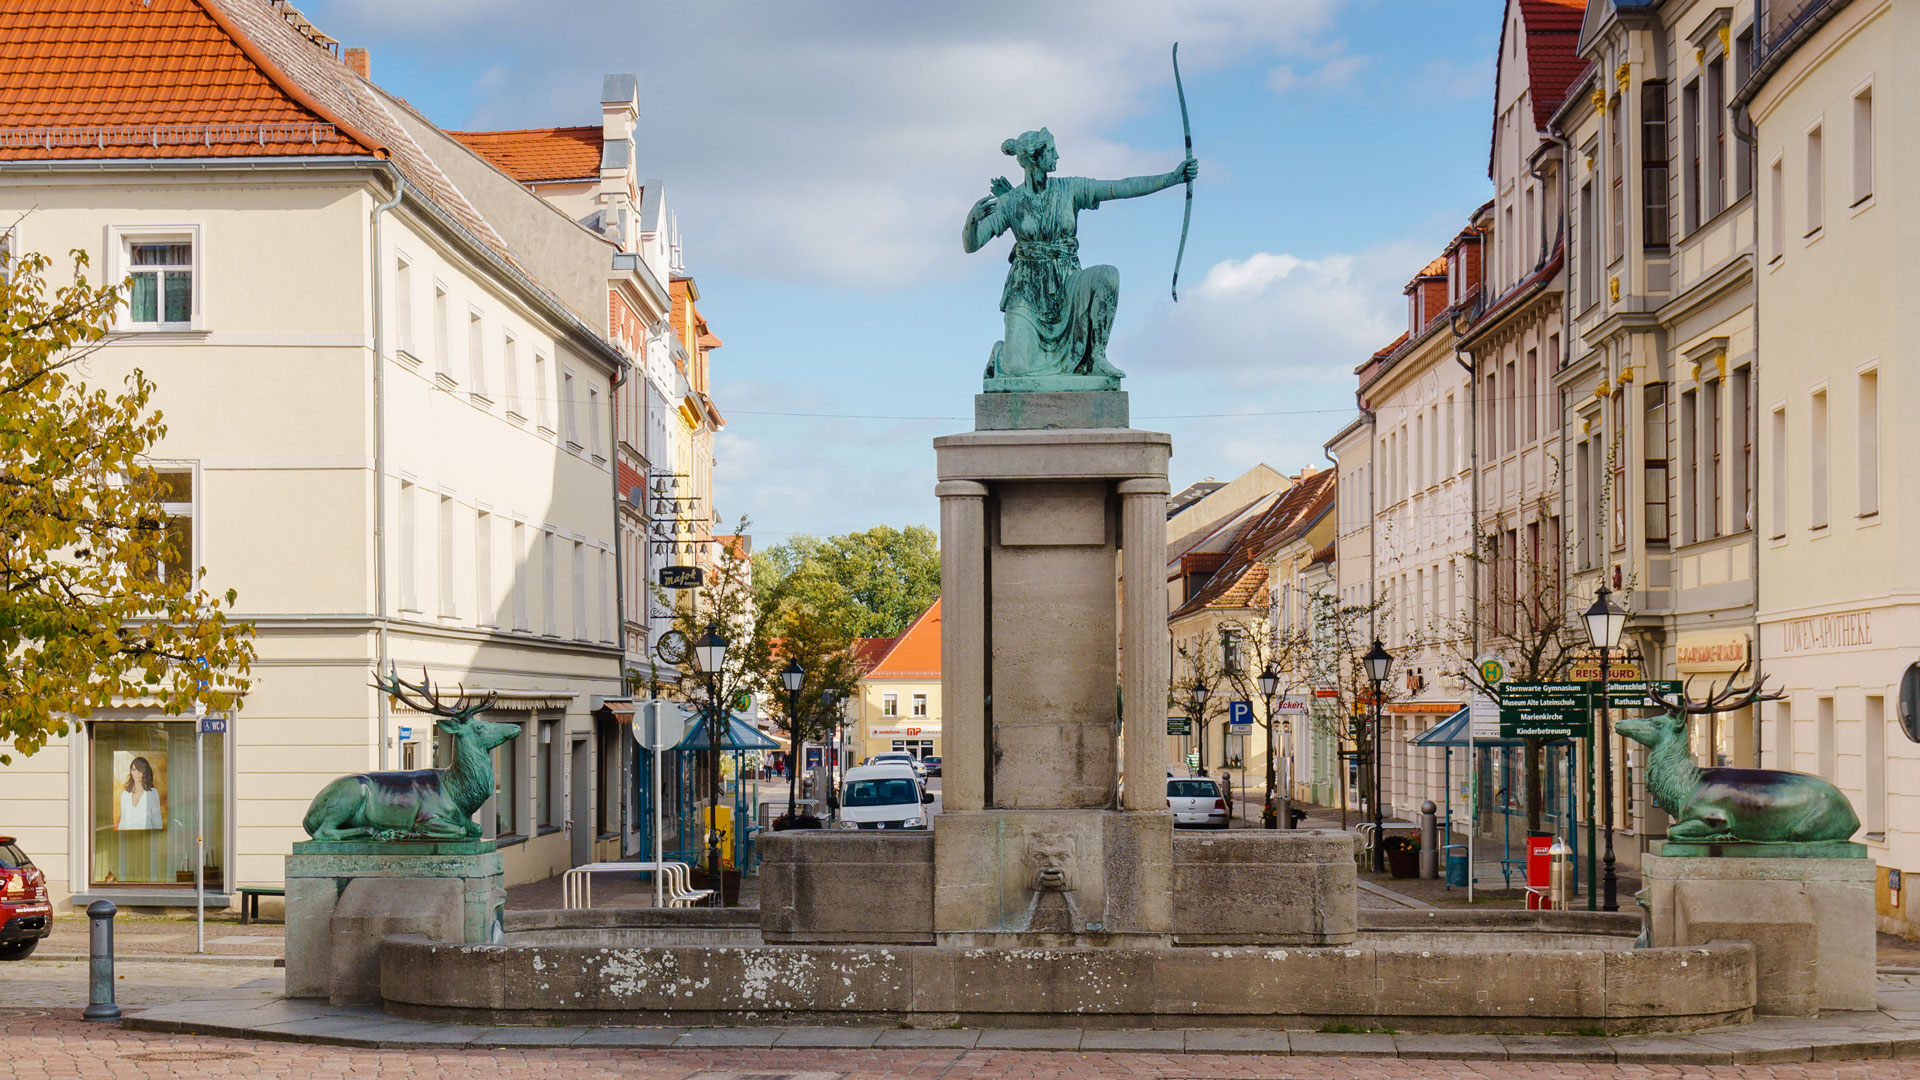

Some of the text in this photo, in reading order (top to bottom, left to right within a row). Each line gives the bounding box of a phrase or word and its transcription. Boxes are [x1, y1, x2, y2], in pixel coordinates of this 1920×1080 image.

[1505, 684, 1581, 693] Sternwarte Gymnasium
[1540, 698, 1576, 706] Lateinschule
[1614, 698, 1642, 706] Rathaus
[1235, 703, 1248, 722] P
[1520, 713, 1563, 721] Marienkirche
[211, 721, 221, 730] WC
[1516, 727, 1572, 736] Kinderbetreuung
